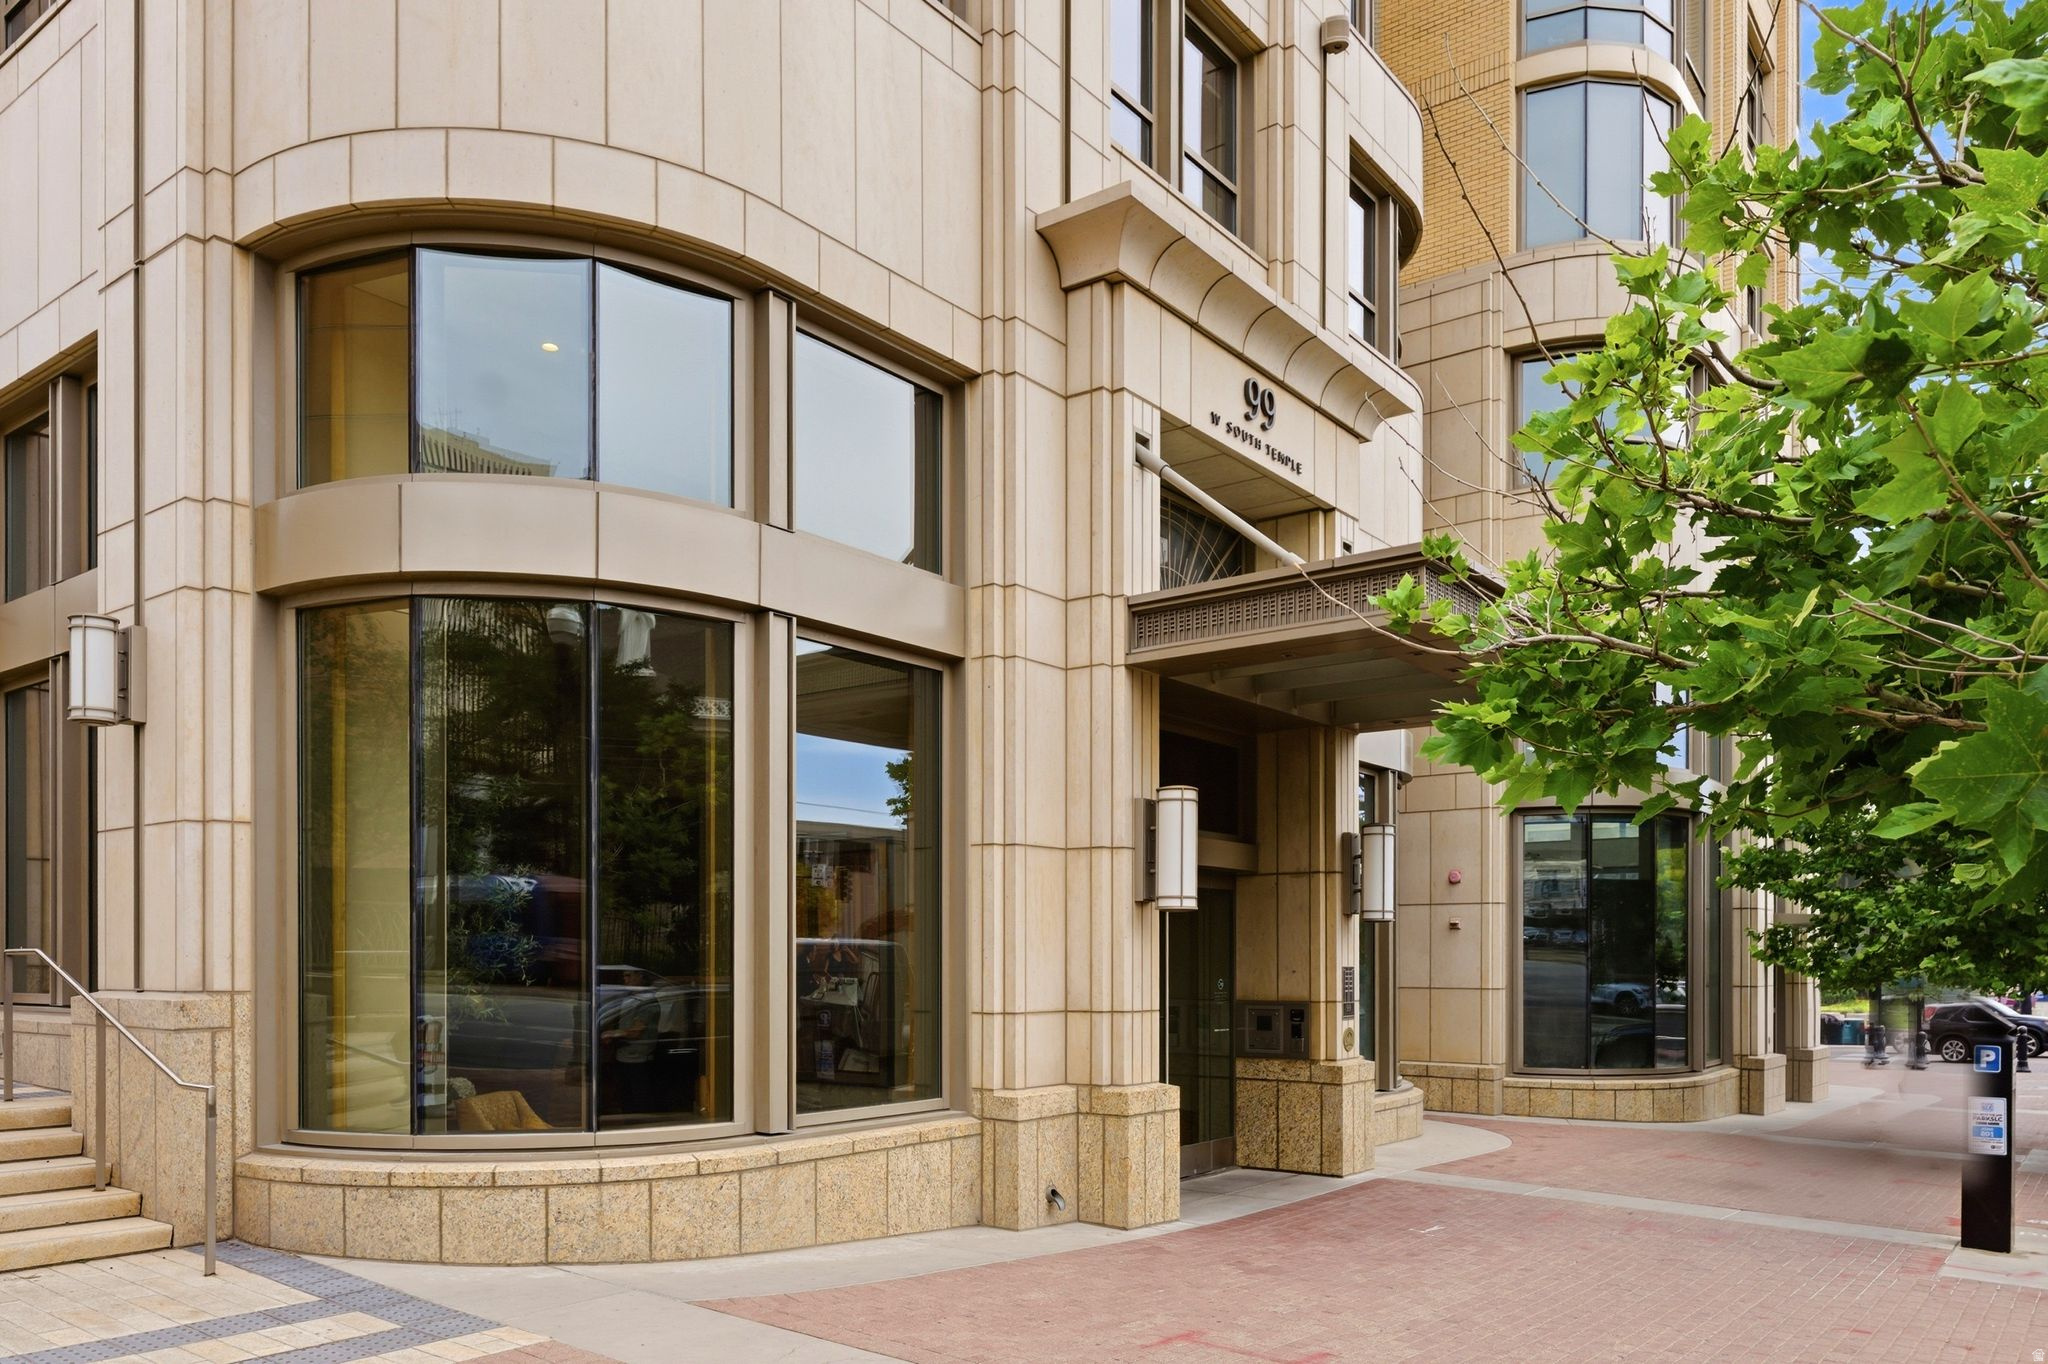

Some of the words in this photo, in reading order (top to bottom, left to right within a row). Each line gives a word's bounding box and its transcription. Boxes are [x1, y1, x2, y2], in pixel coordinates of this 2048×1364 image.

[1243, 377, 1276, 432] 99
[1210, 411, 1221, 426] W
[1225, 421, 1262, 450] SOUTH
[1265, 443, 1303, 475] TEMPLE
[1980, 1049, 1996, 1067] P
